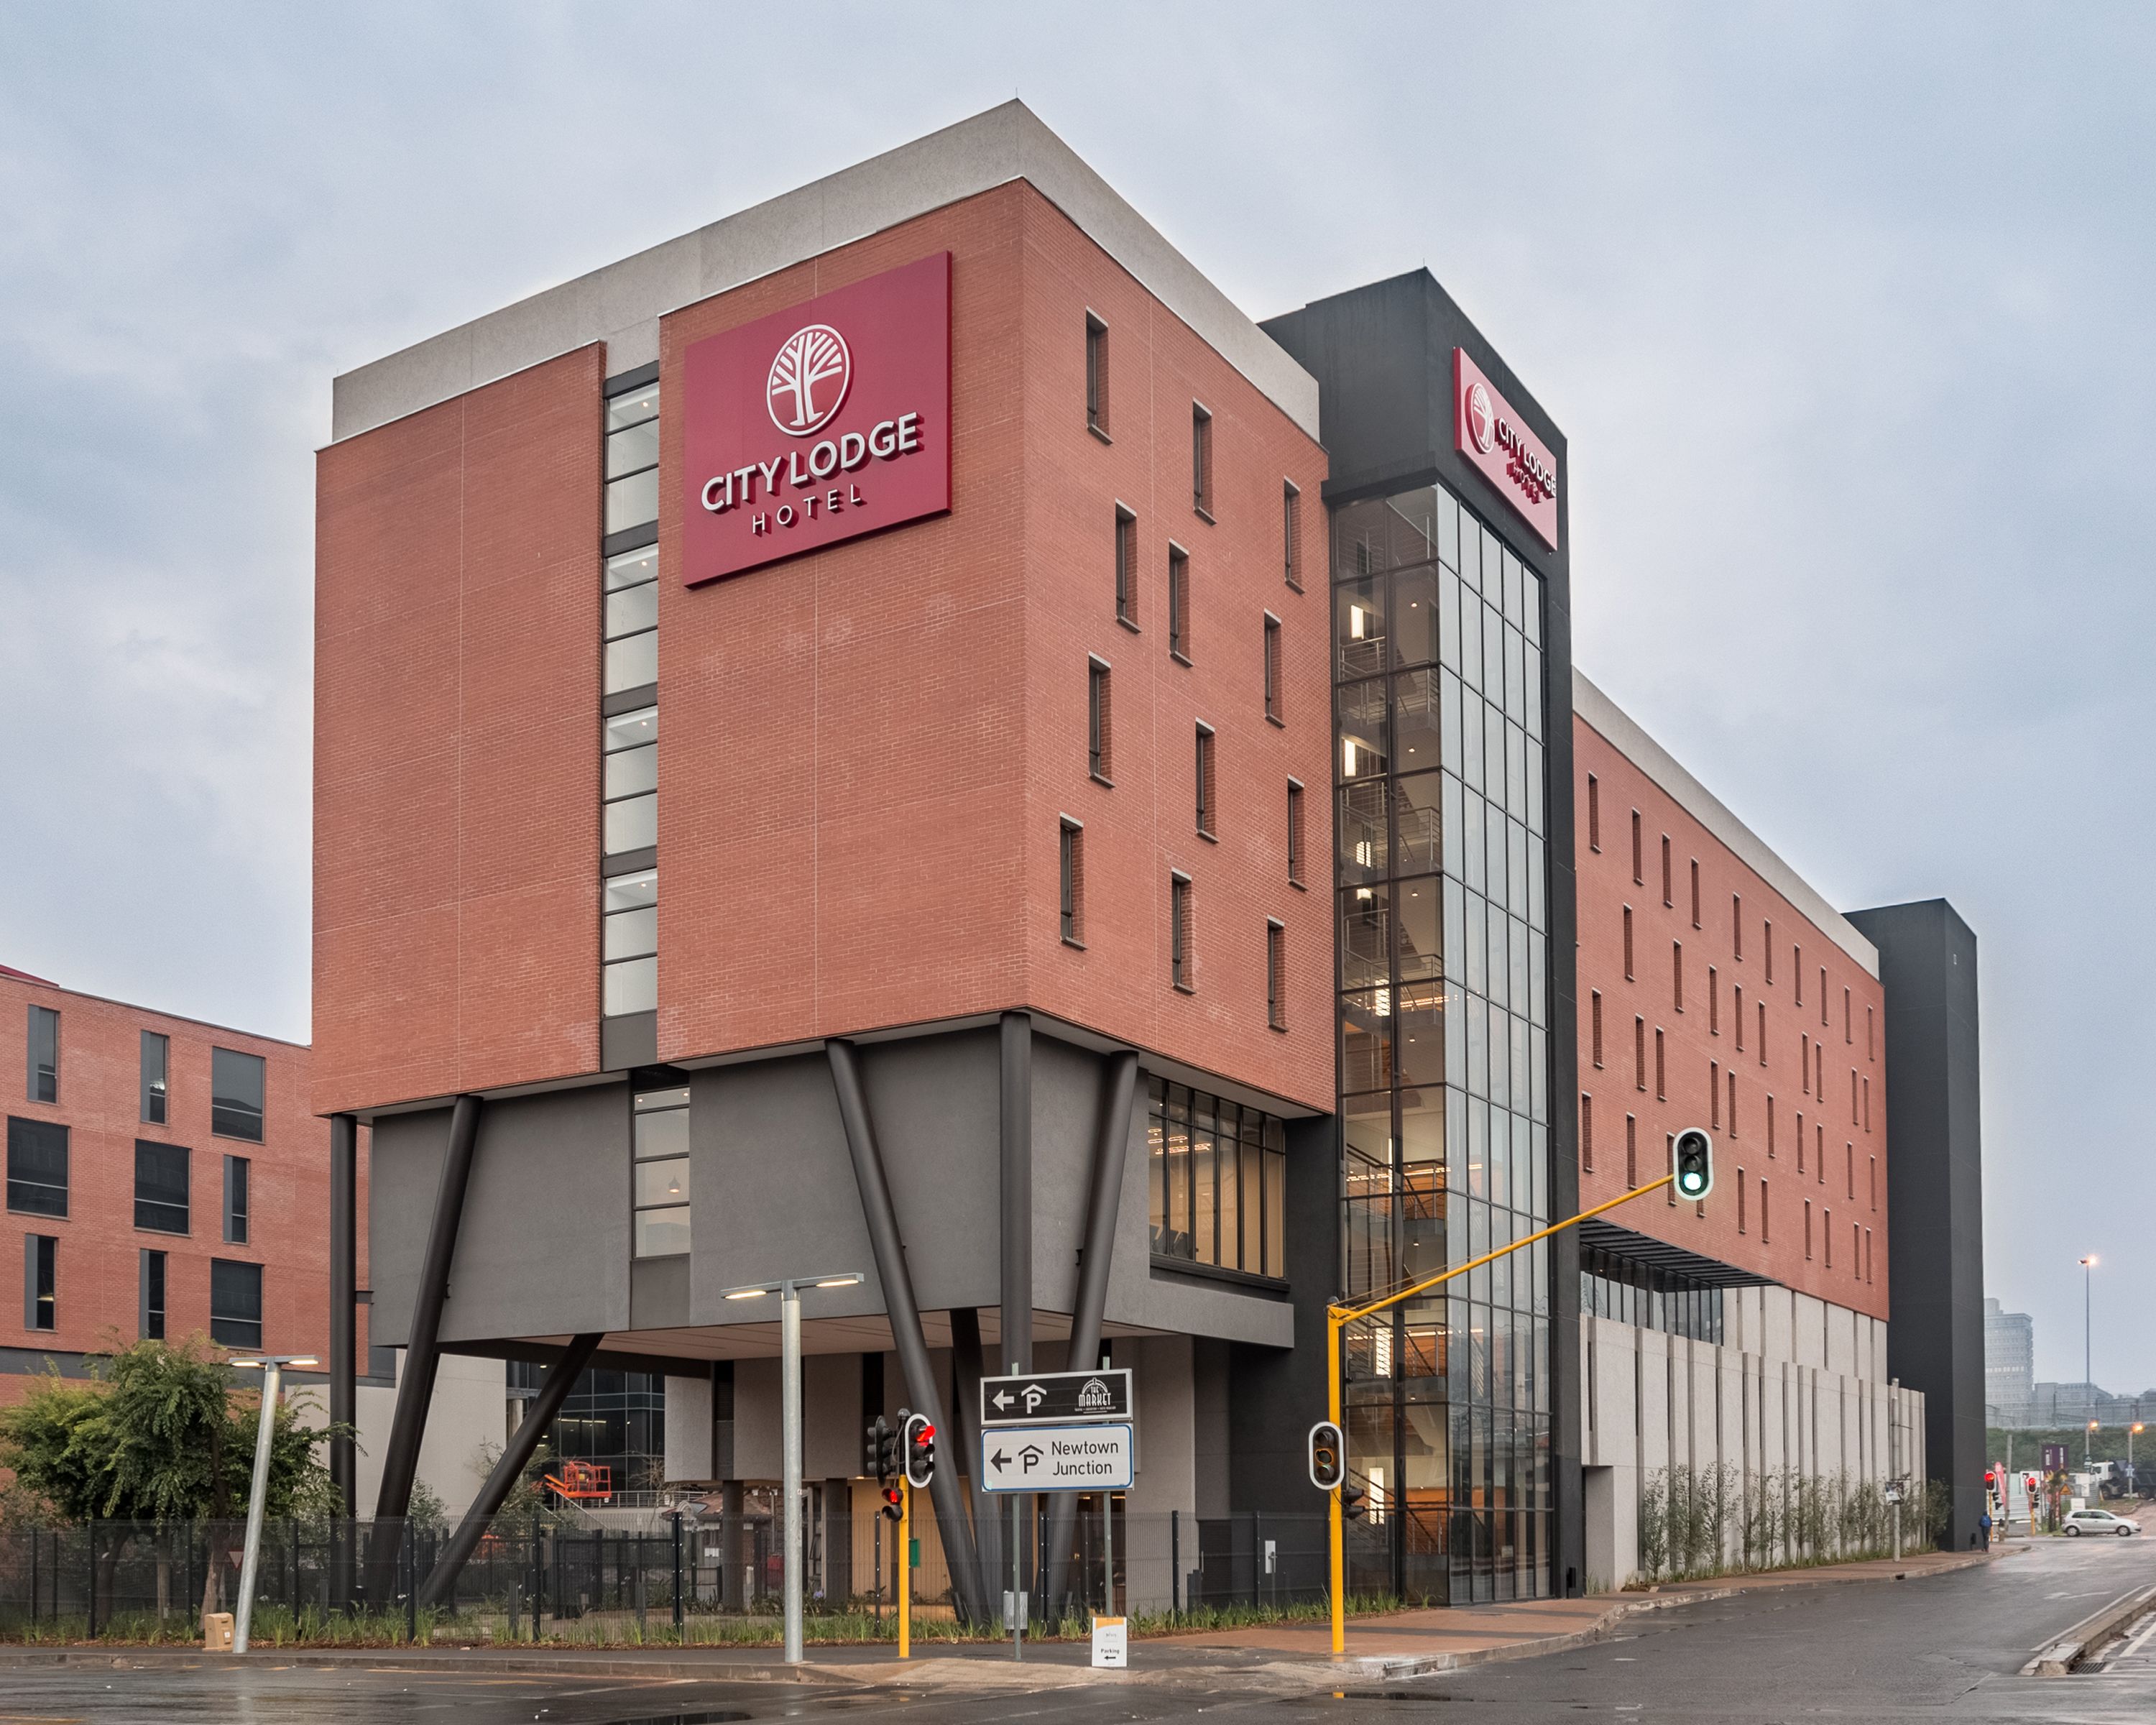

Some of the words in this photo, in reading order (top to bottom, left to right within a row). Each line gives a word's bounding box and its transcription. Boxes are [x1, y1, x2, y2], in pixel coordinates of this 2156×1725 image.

[701, 456, 783, 512] CITY
[791, 412, 918, 486] LODGE
[1498, 417, 1522, 457] CITY
[1524, 443, 1556, 497] LODGE
[752, 483, 862, 534] HOTEL
[1078, 1392, 1111, 1407] MARKET
[1051, 1440, 1119, 1455] Newtown
[1052, 1460, 1112, 1476] Junction
